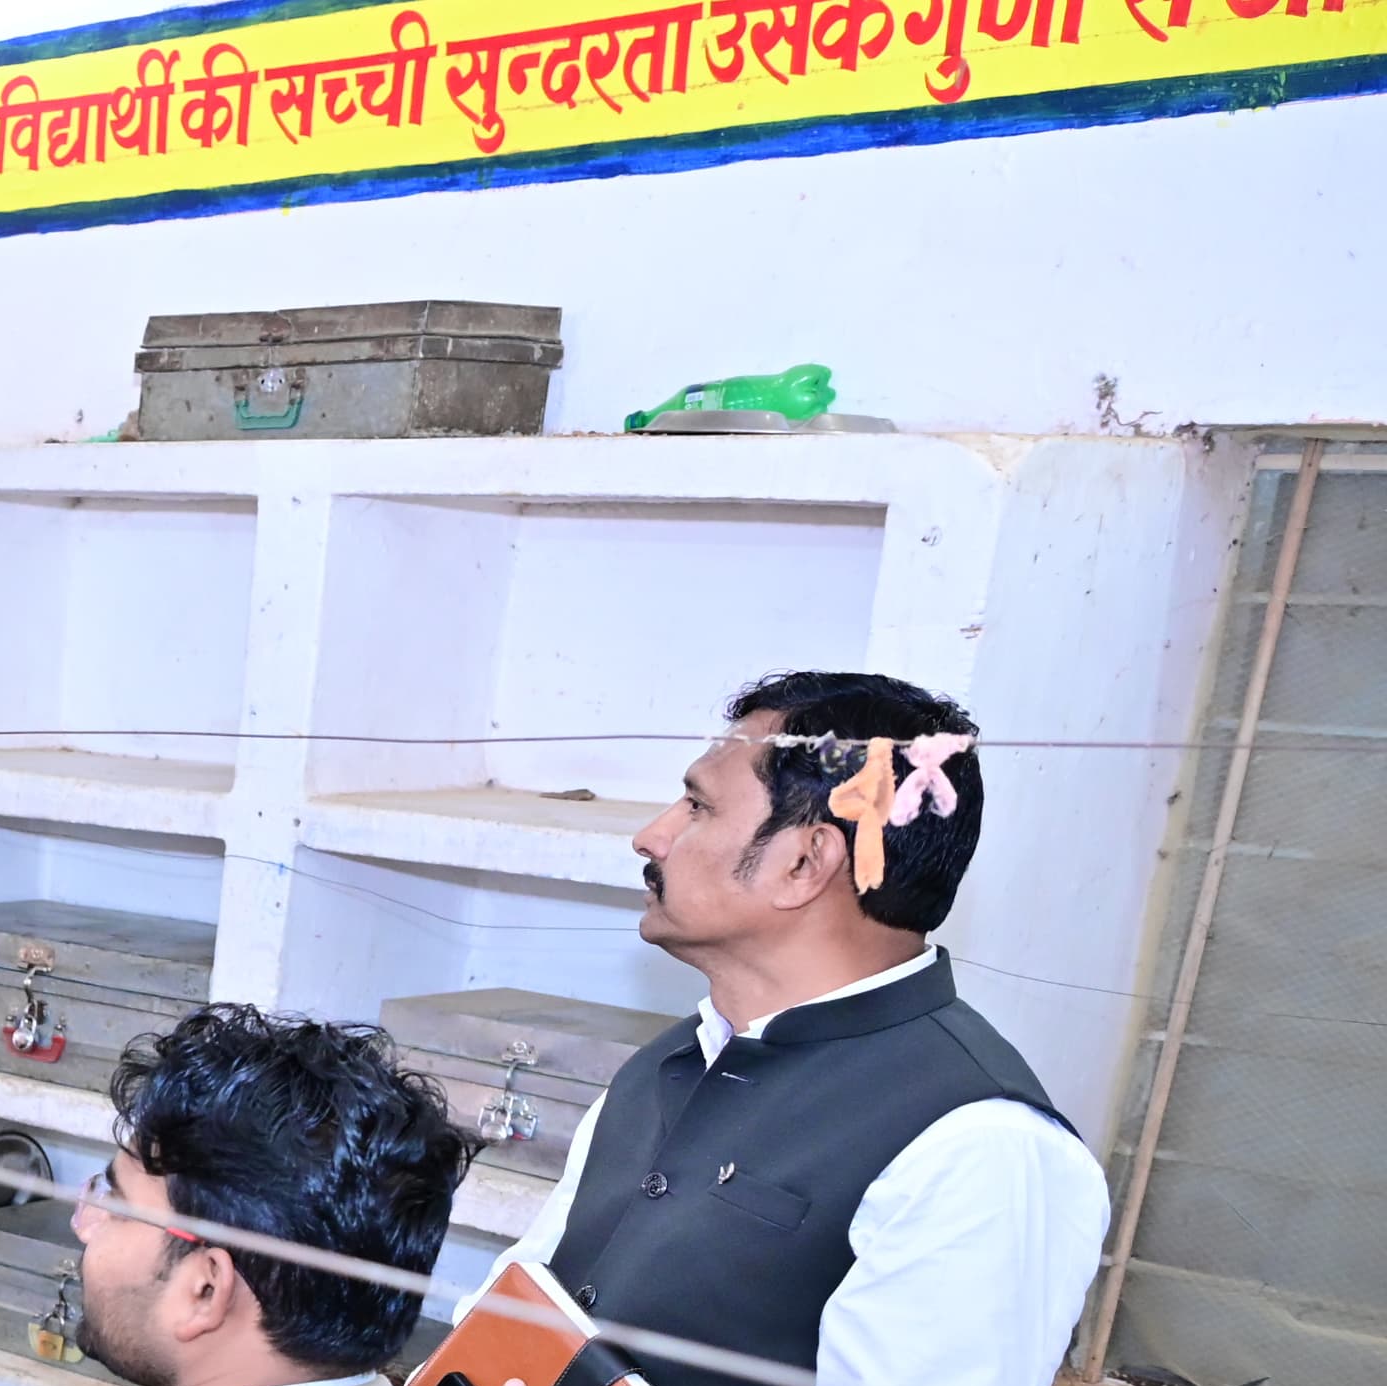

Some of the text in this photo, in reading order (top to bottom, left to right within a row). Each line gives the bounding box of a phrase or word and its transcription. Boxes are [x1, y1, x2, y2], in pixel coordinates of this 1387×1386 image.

[181, 43, 258, 148] की
[264, 10, 437, 145] सच्ची
[445, 1, 702, 154] सुन्दरता
